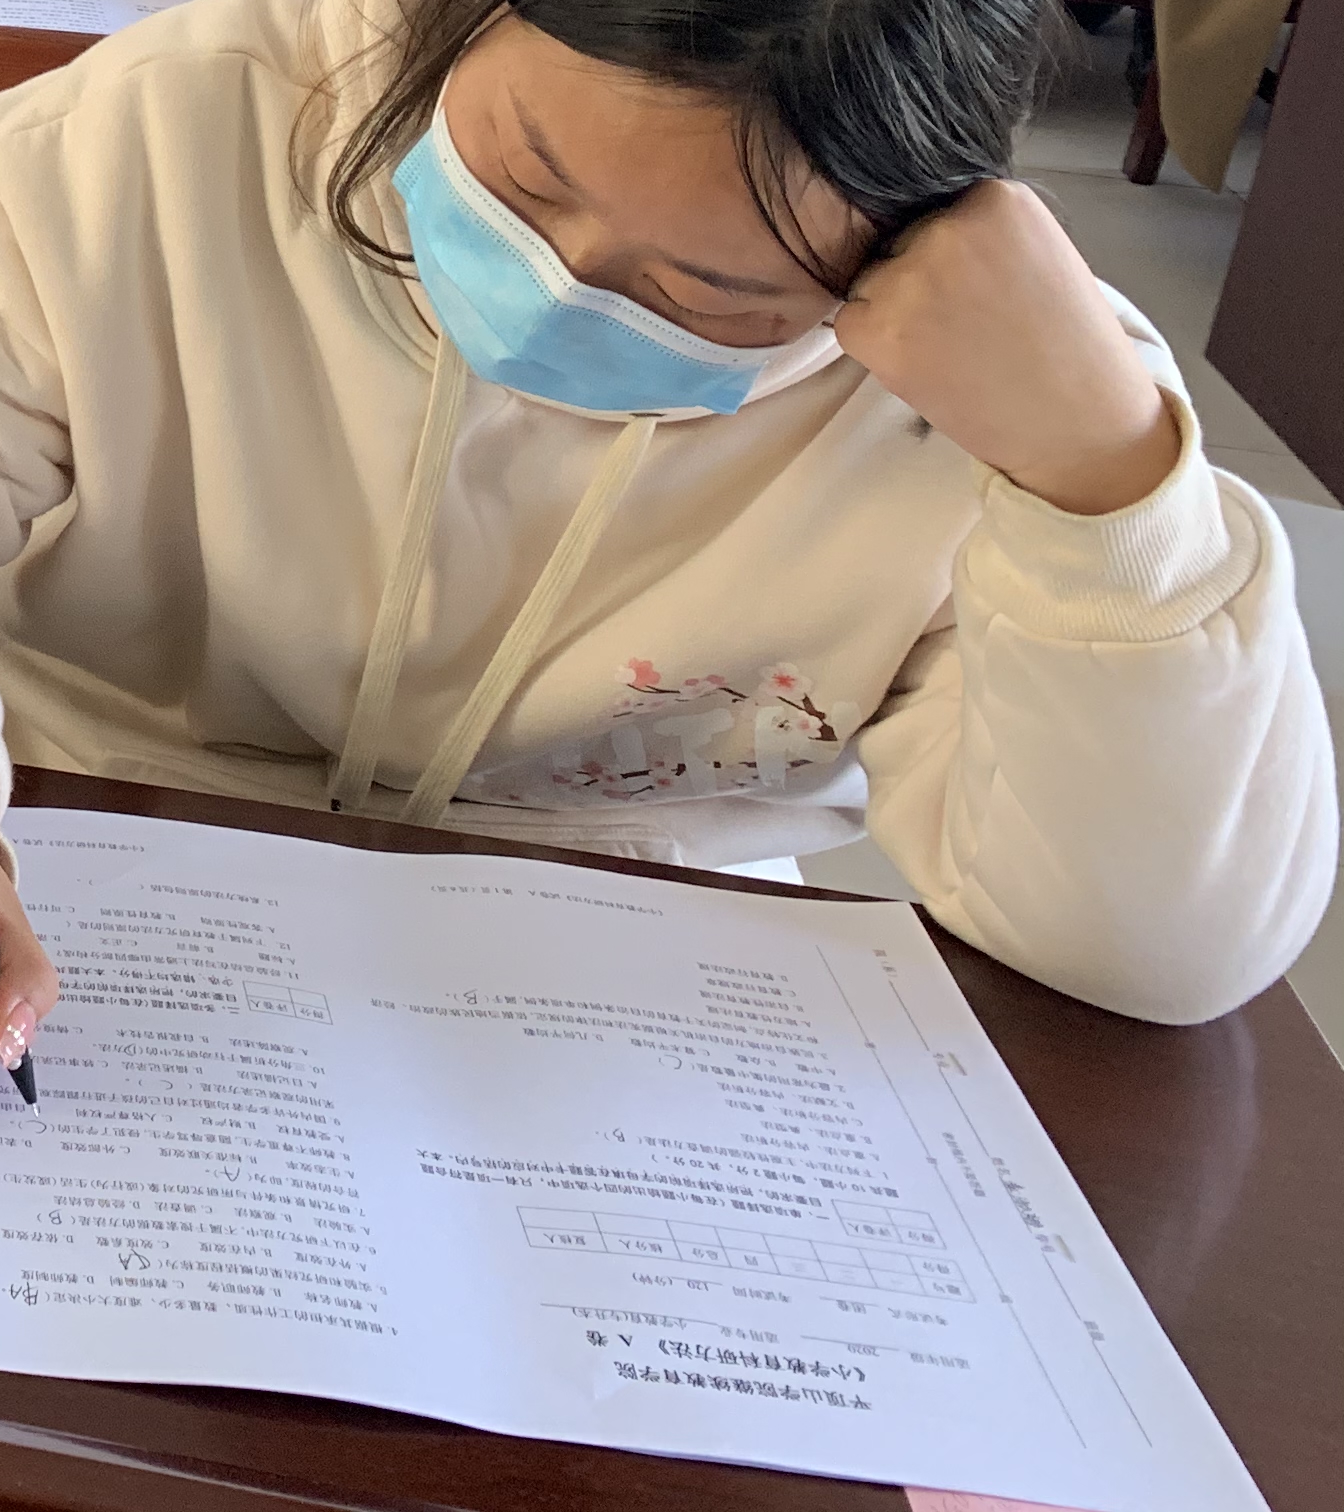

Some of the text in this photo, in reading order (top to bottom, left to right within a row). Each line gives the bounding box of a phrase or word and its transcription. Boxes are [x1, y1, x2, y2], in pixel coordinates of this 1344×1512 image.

[658, 1339, 866, 1383] 《小学教育科研方法》
[613, 1361, 872, 1411] 平顶山学院继续教育学院
